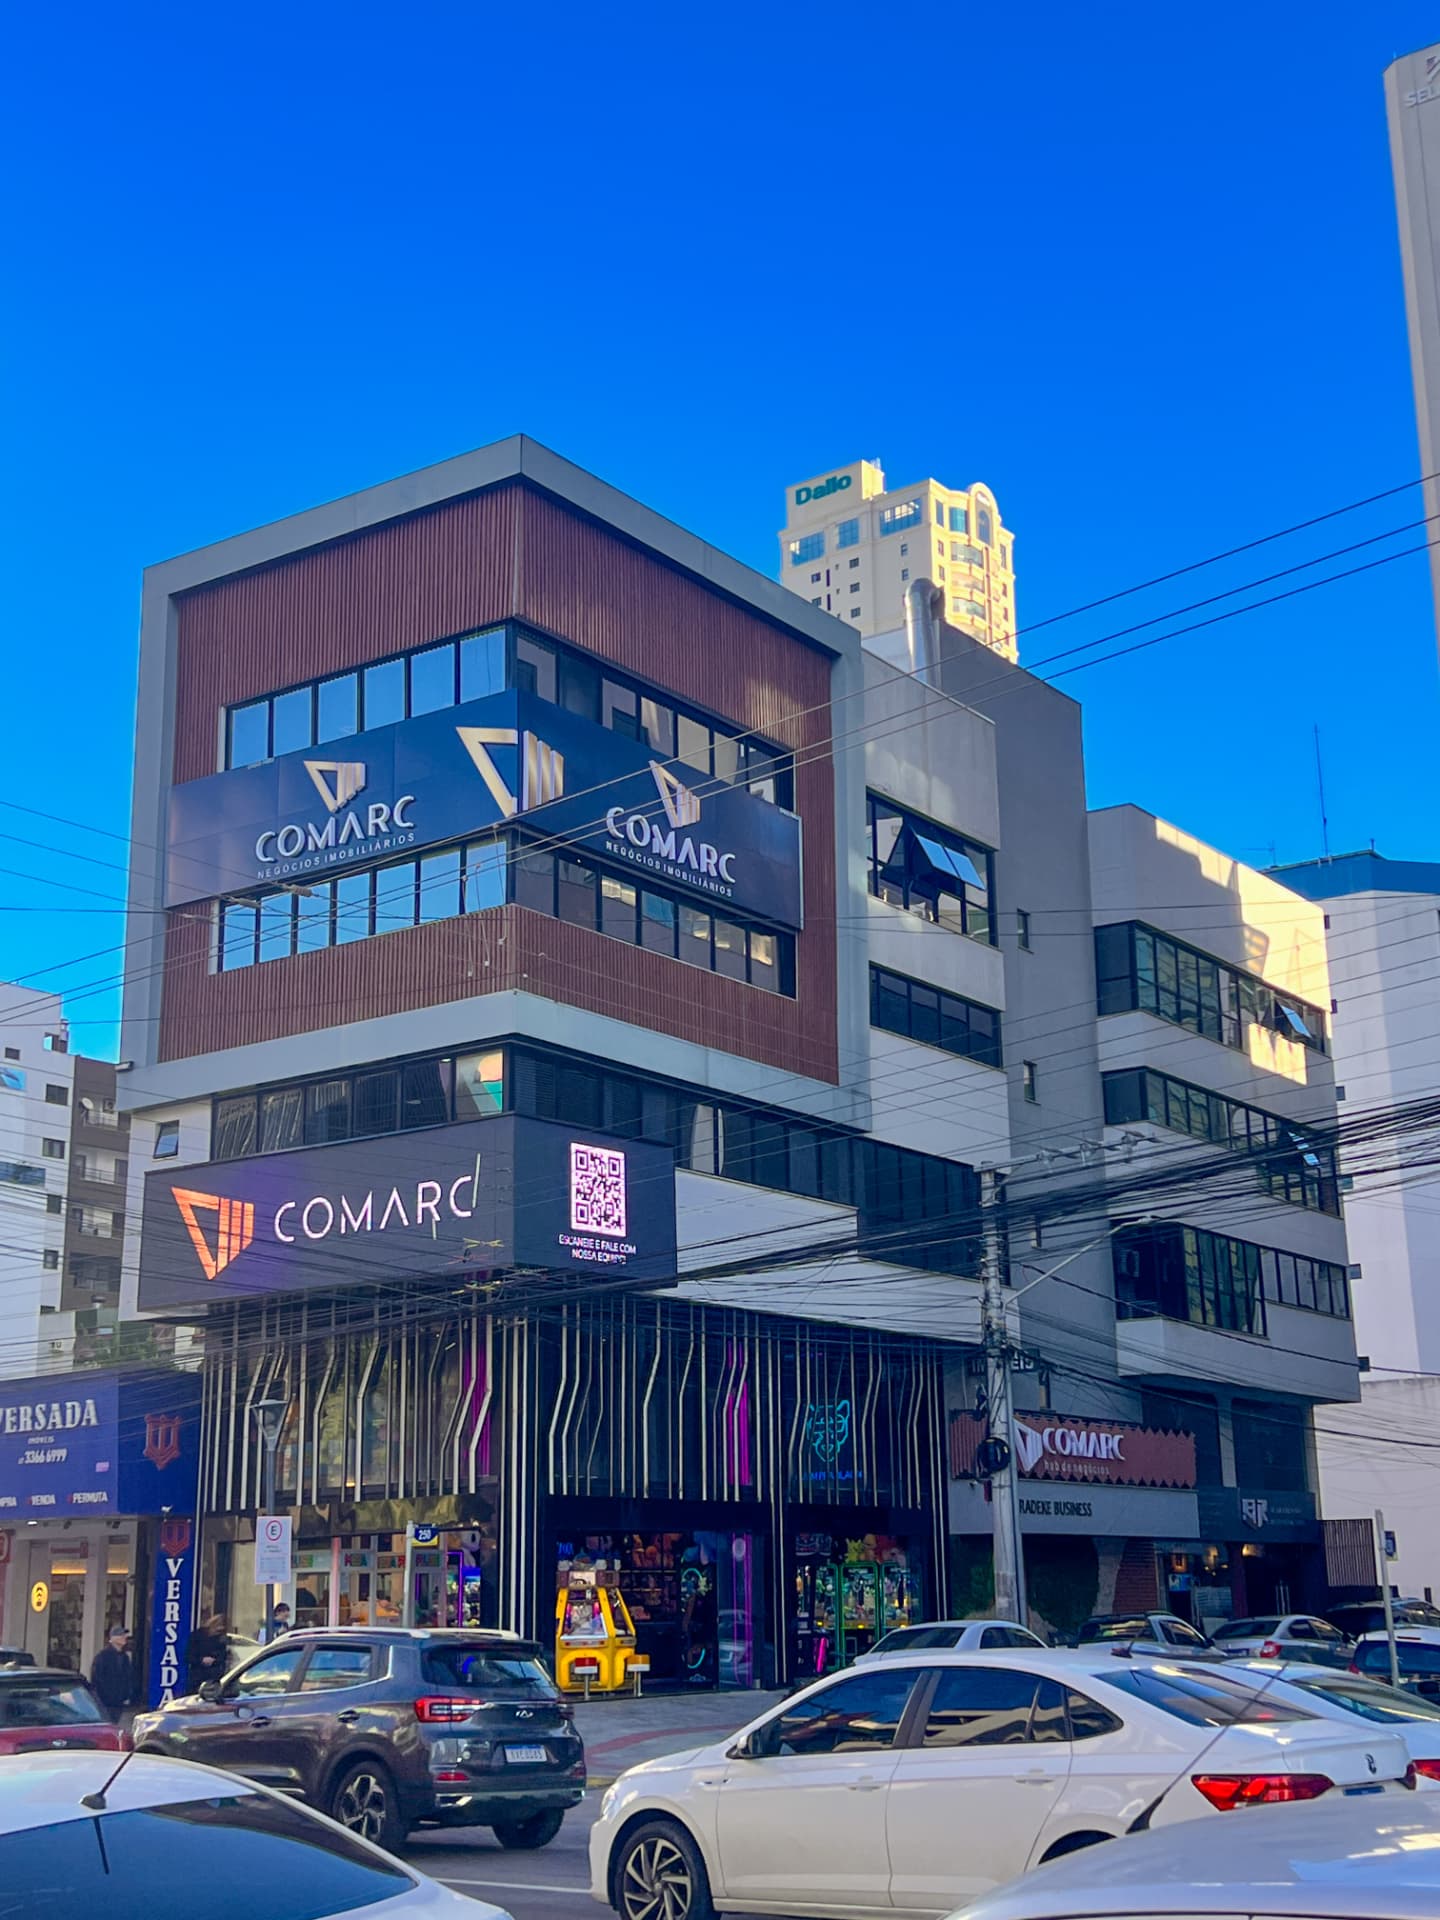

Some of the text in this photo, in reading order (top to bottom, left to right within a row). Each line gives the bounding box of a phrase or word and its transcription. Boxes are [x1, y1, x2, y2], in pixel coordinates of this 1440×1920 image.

[255, 795, 415, 862] COMARC
[606, 807, 736, 884] COMARC
[257, 832, 415, 879] NEGÓCIOS IMOBILIÁRIOS
[606, 840, 732, 897] NEGÓCIOS IMOBILIÁRIOS
[274, 1175, 472, 1243] COMARC
[0, 1398, 99, 1434] ERSADA
[1042, 1427, 1126, 1461] COMARC
[271, 1525, 279, 1536] E
[1054, 1502, 1093, 1517] BUSINESS
